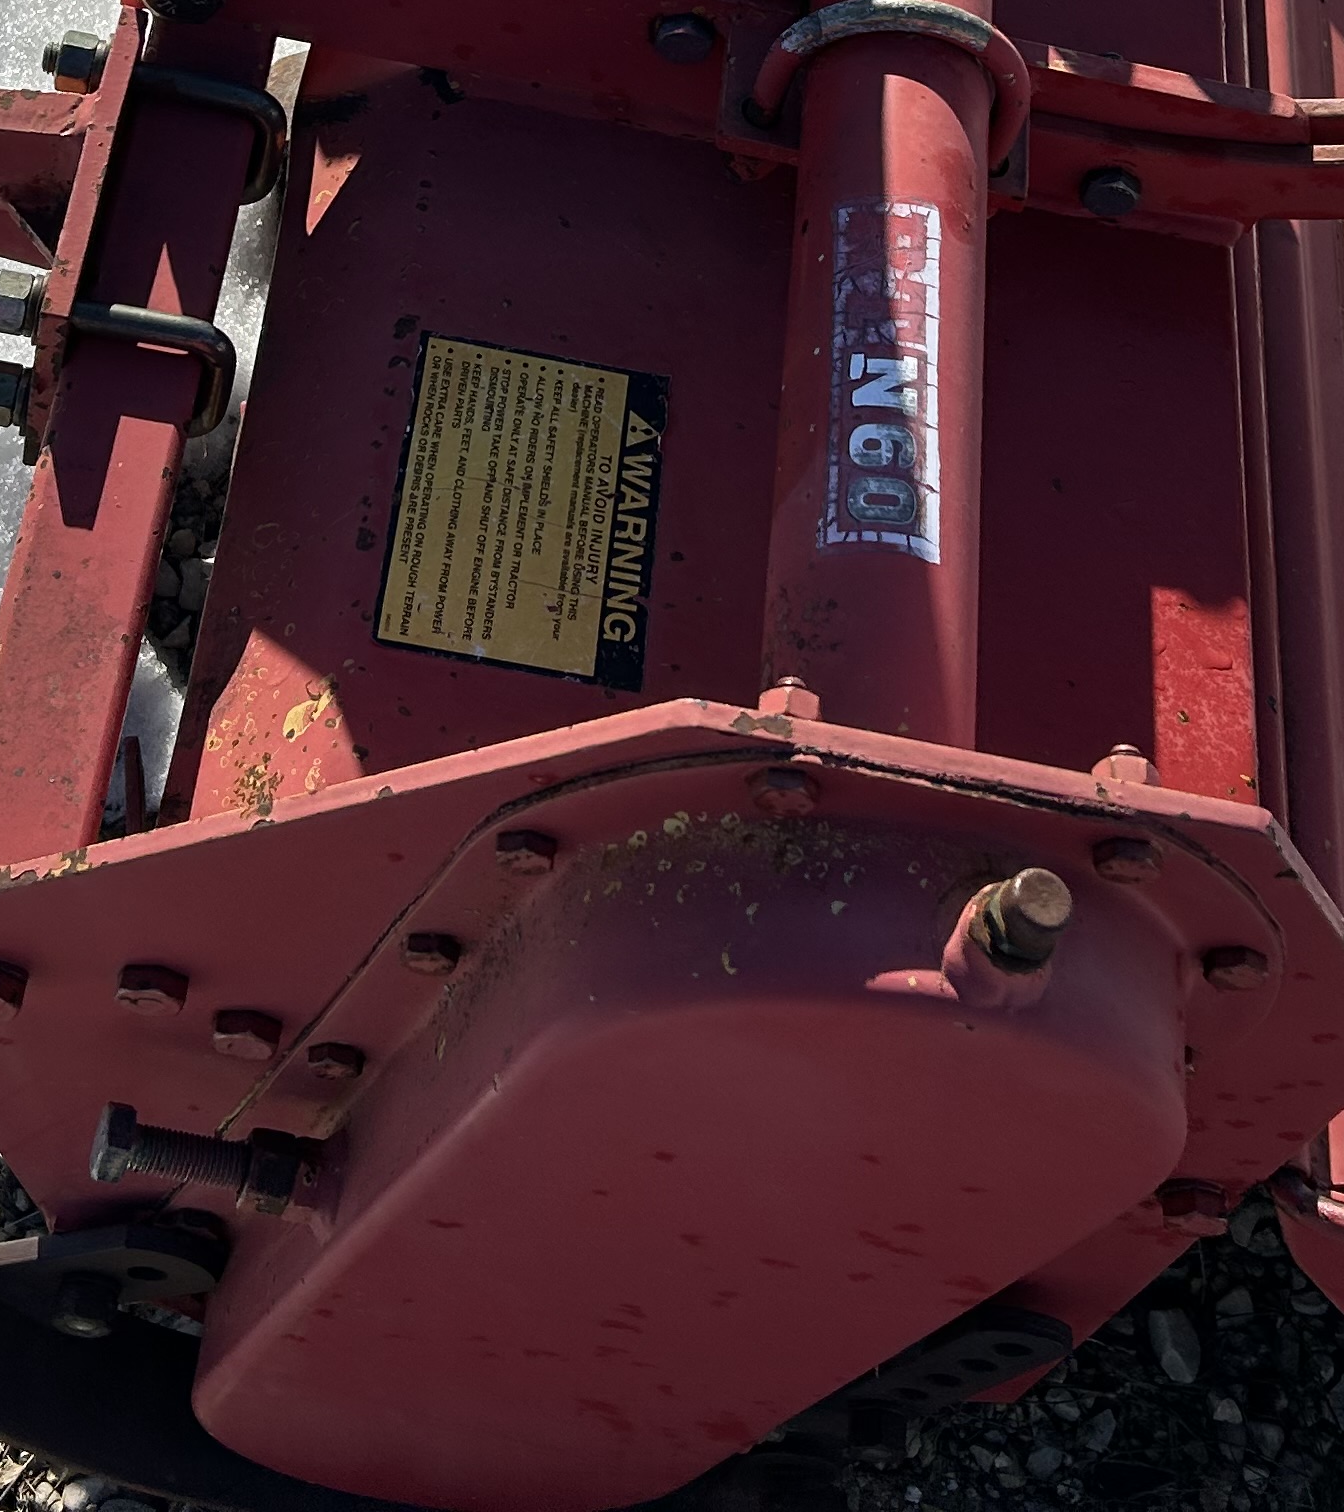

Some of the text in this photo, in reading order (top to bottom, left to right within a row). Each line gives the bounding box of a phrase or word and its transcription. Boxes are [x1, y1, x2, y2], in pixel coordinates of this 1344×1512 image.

[451, 361, 470, 429] DRIVEN PARTS
[469, 363, 482, 388] KEEP
[481, 366, 499, 432] DISMOUNTING
[567, 381, 580, 413] dealer)
[398, 355, 441, 564] OR WHEN ROCKS OR DEBRIS ARE PRESENT
[398, 357, 453, 636] USE EXTRA CARE WHEN OPERATING ON ROUGH TERRAIN
[447, 478, 464, 530] CLOTHING
[456, 455, 467, 476] AND
[461, 368, 511, 641] STOP POWER TAKE OFF AND SHUT OFF ENGINE BEFORE
[481, 372, 528, 640] OPERATE ONLY AT SAFE DISTANCE FROM BYSTANDERS
[505, 375, 546, 609] ALLOW NO RIDERS ON IMPLEMENT OR TRACTOR
[531, 378, 563, 555] KEEP ALL SAFETY SHIELDS IN PLACE
[549, 384, 592, 640] MACHINE (replacement manuals are available from your
[567, 386, 604, 621] READ OPERATORS MANUAL BEFORE USING THIS
[585, 453, 612, 584] TO AVOID INJURY
[437, 562, 451, 593] FROM
[442, 531, 455, 560] AWAY
[602, 448, 654, 644] WARNING
[430, 594, 446, 634] POWER
